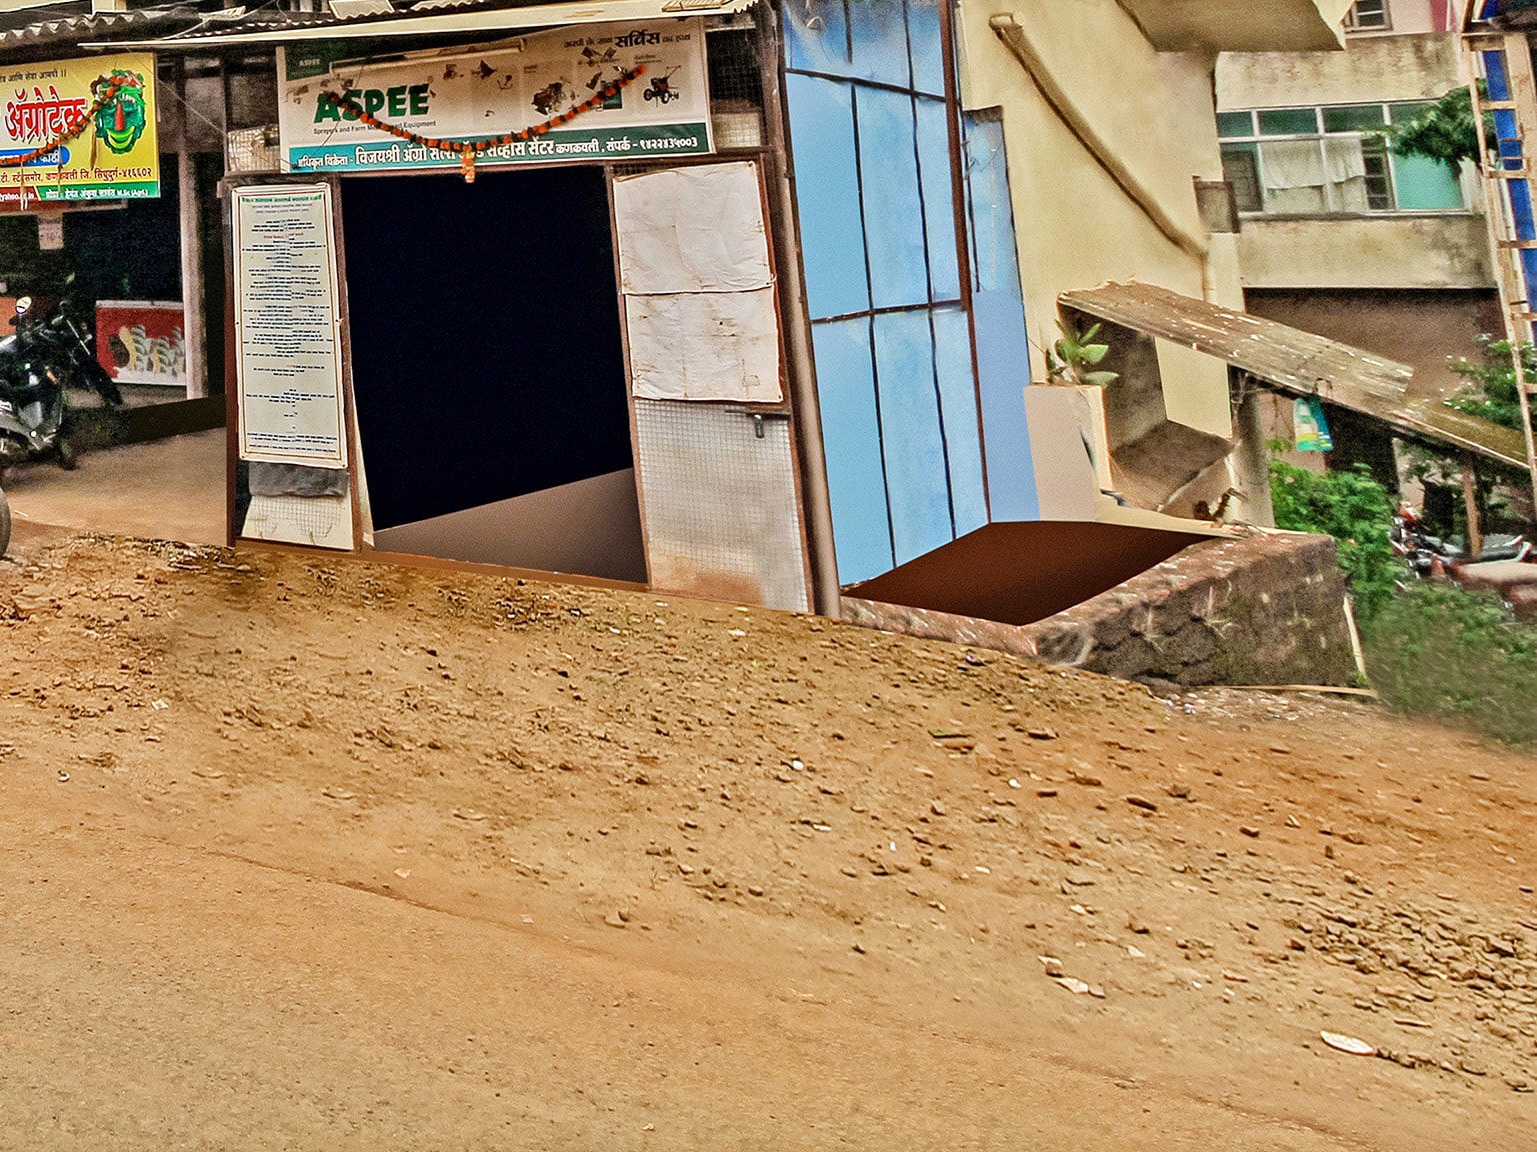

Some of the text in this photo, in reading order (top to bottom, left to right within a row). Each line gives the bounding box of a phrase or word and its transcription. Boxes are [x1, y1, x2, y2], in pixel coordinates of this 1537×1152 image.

[614, 29, 661, 48] सर्विस
[314, 83, 430, 124] ASPEE
[313, 127, 338, 135] Sprayers
[403, 120, 436, 129] Equipment
[355, 144, 400, 166] विजयश्री
[528, 136, 554, 155] सेंटर
[555, 138, 600, 154] कणकवली
[606, 136, 631, 153] संपर्क
